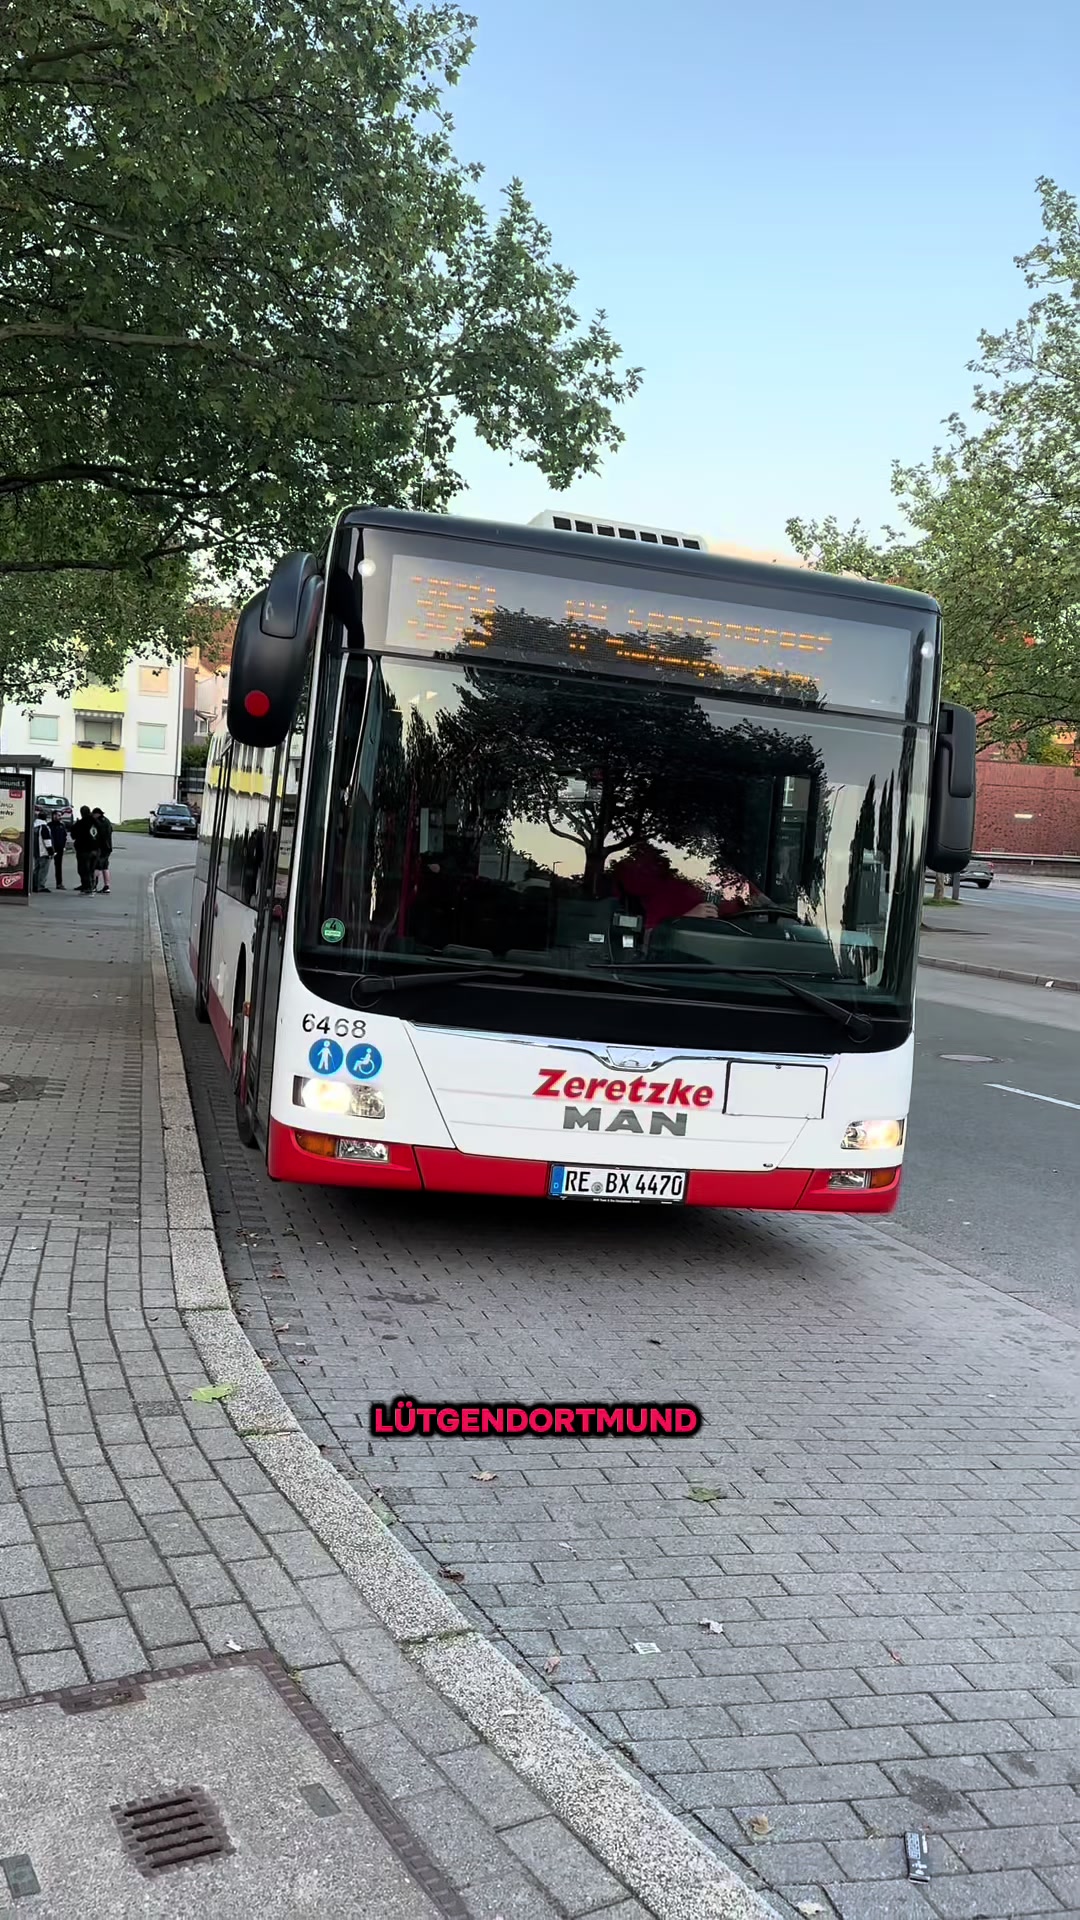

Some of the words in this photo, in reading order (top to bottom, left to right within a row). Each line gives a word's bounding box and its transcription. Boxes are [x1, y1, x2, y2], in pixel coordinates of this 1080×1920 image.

[302, 1013, 367, 1038] 6468
[532, 1068, 713, 1107] Zeretzke
[563, 1106, 688, 1136] MAN
[565, 1171, 591, 1192] RE
[605, 1172, 631, 1194] BX
[635, 1174, 683, 1195] 4470
